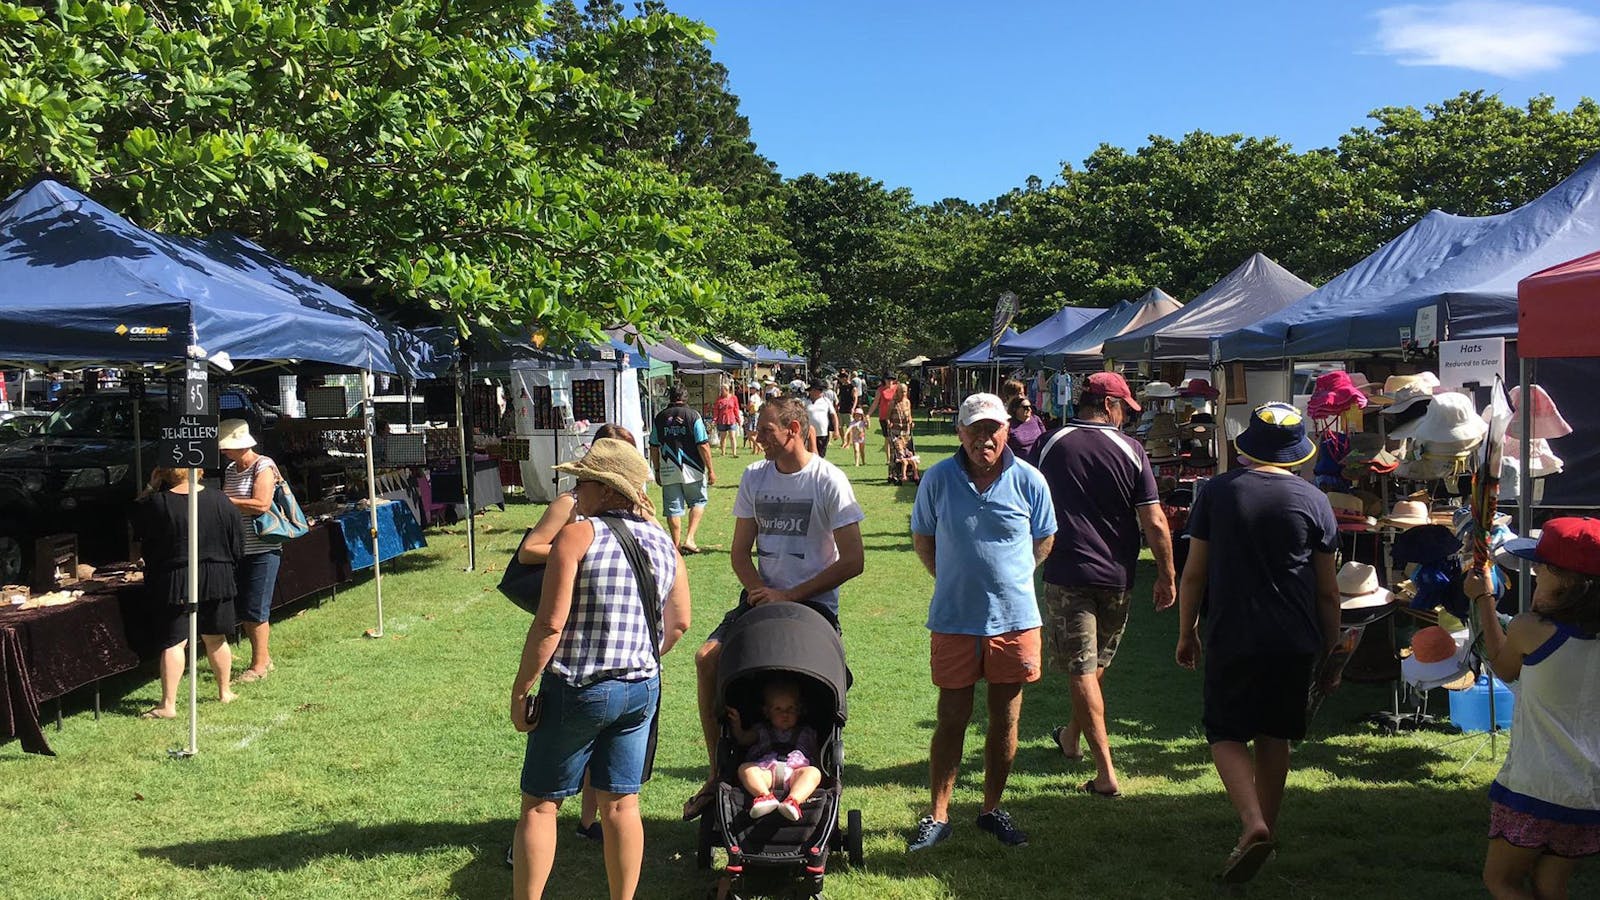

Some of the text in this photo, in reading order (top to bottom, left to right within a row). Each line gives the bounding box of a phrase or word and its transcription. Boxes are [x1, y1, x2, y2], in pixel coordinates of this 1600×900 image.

[1460, 344, 1482, 353] Hats
[190, 384, 204, 410] $5
[179, 416, 200, 426] ALL
[162, 427, 218, 439] JEWELLERY
